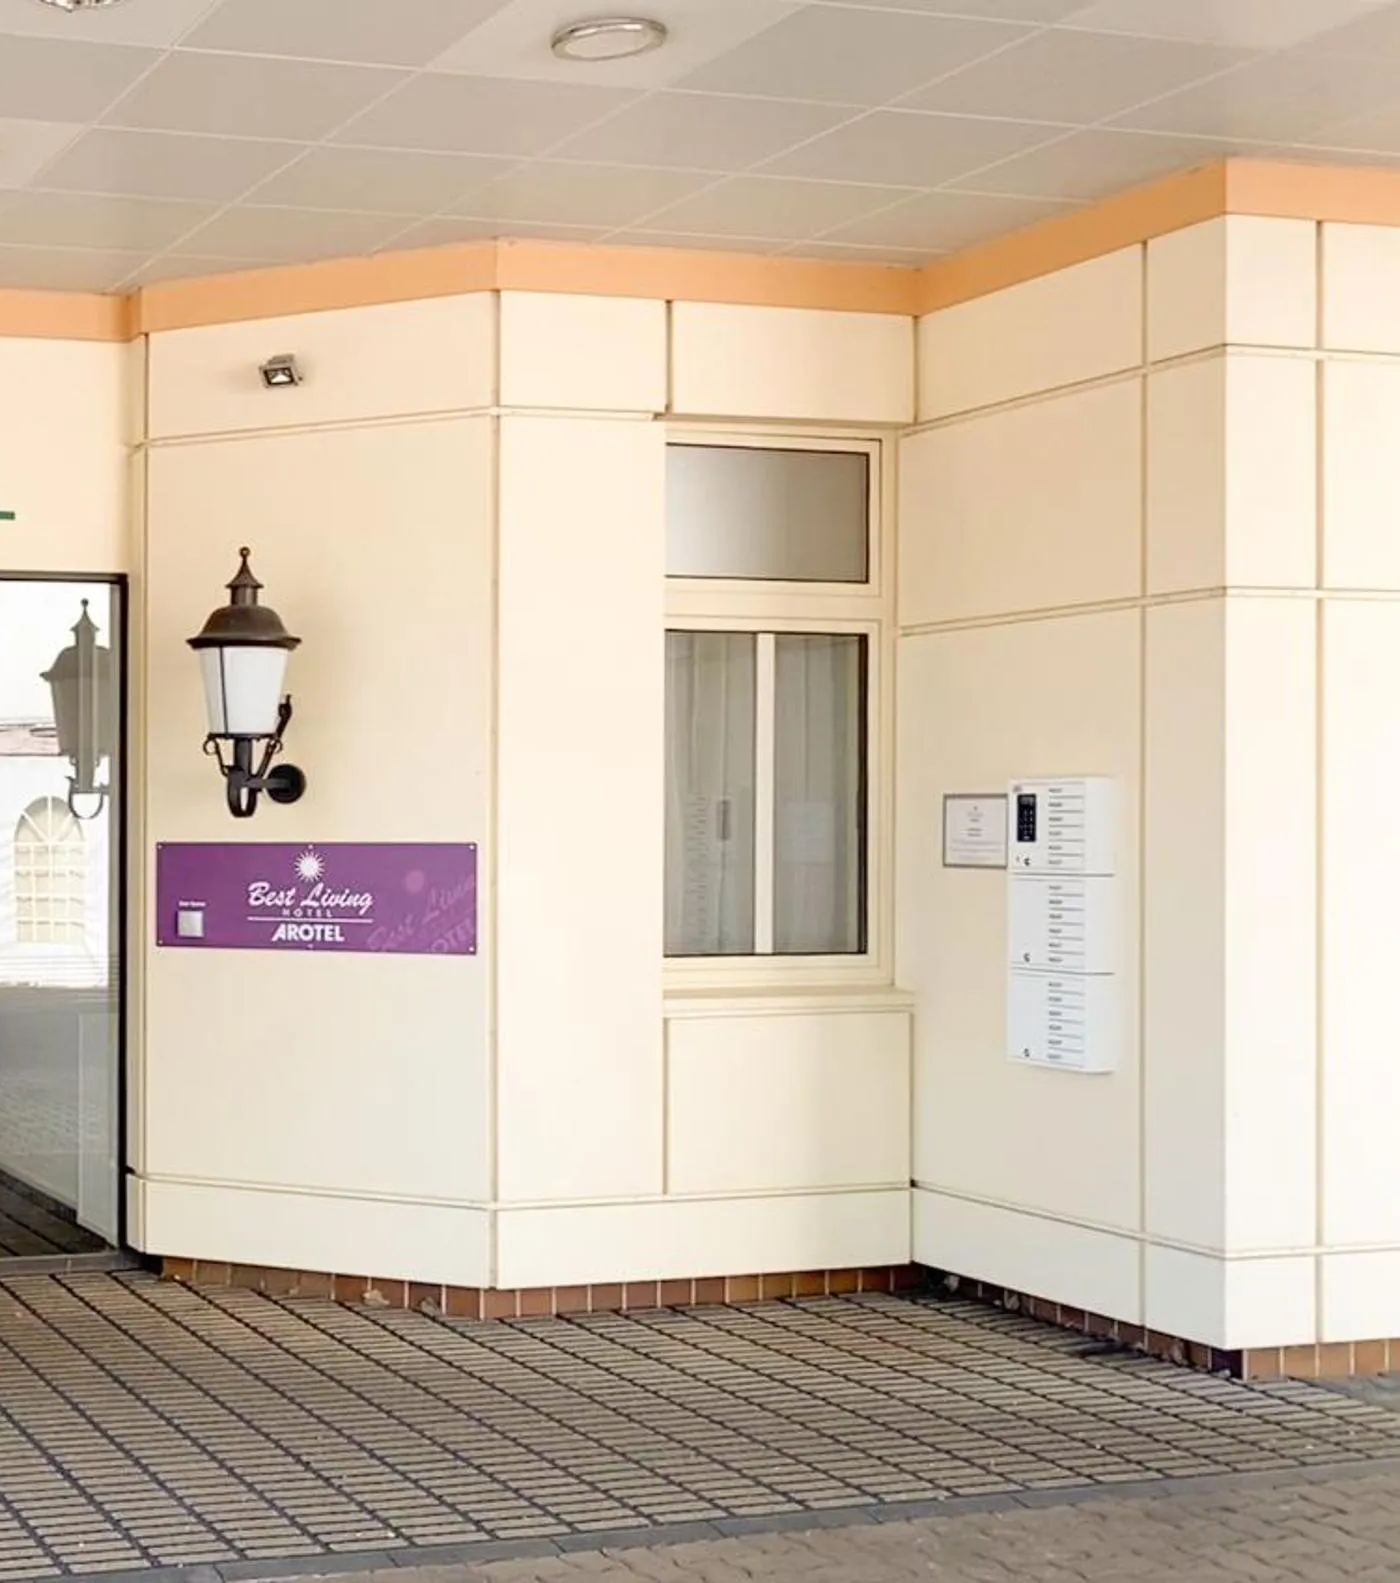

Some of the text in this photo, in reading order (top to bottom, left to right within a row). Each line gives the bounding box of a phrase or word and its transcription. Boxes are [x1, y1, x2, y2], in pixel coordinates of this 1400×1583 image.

[247, 881, 374, 915] Best Living
[281, 908, 334, 918] HOTEL
[271, 923, 346, 942] AROTEL
